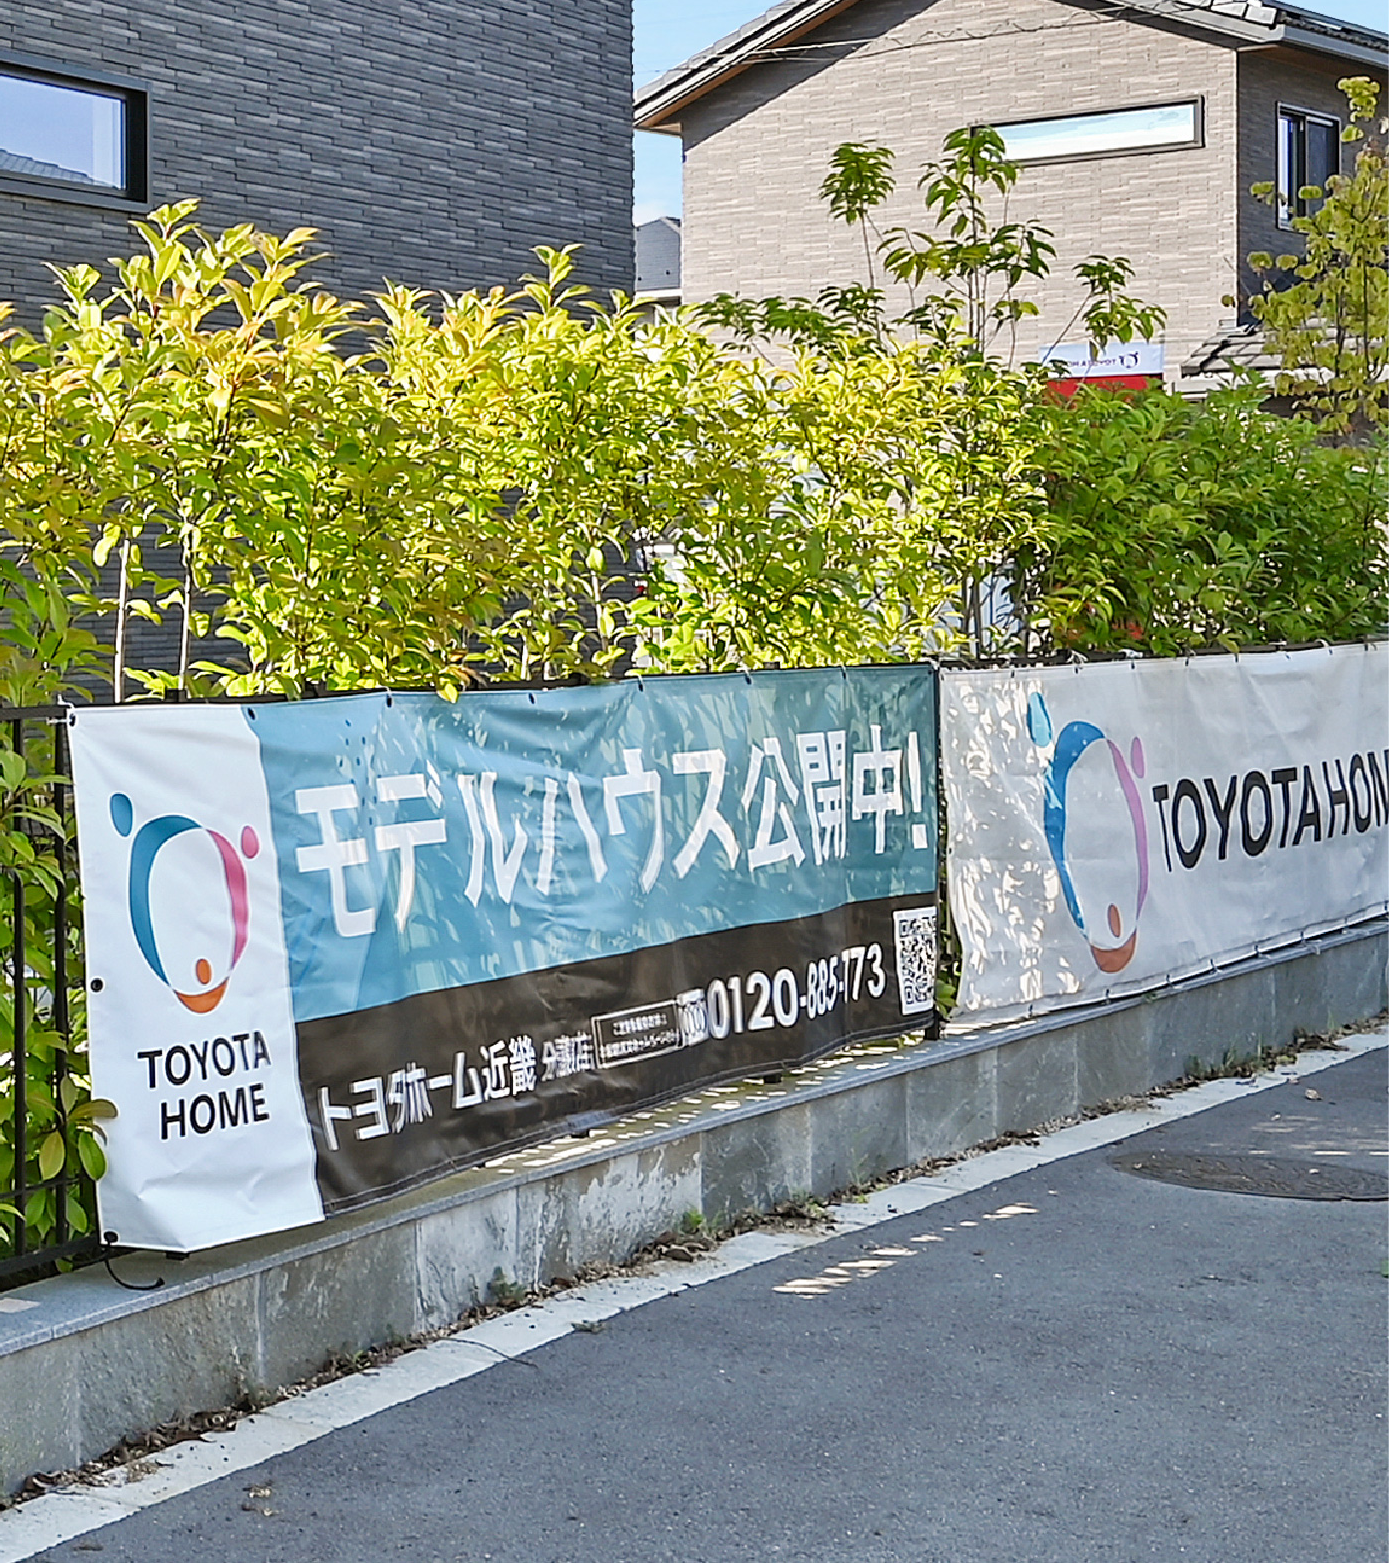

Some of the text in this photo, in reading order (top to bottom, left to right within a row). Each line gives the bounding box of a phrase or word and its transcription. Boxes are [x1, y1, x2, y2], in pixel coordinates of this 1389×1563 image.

[1152, 764, 1322, 873] TOYOTA
[137, 1031, 272, 1089] TOYOTA
[160, 1082, 270, 1140] HOME
